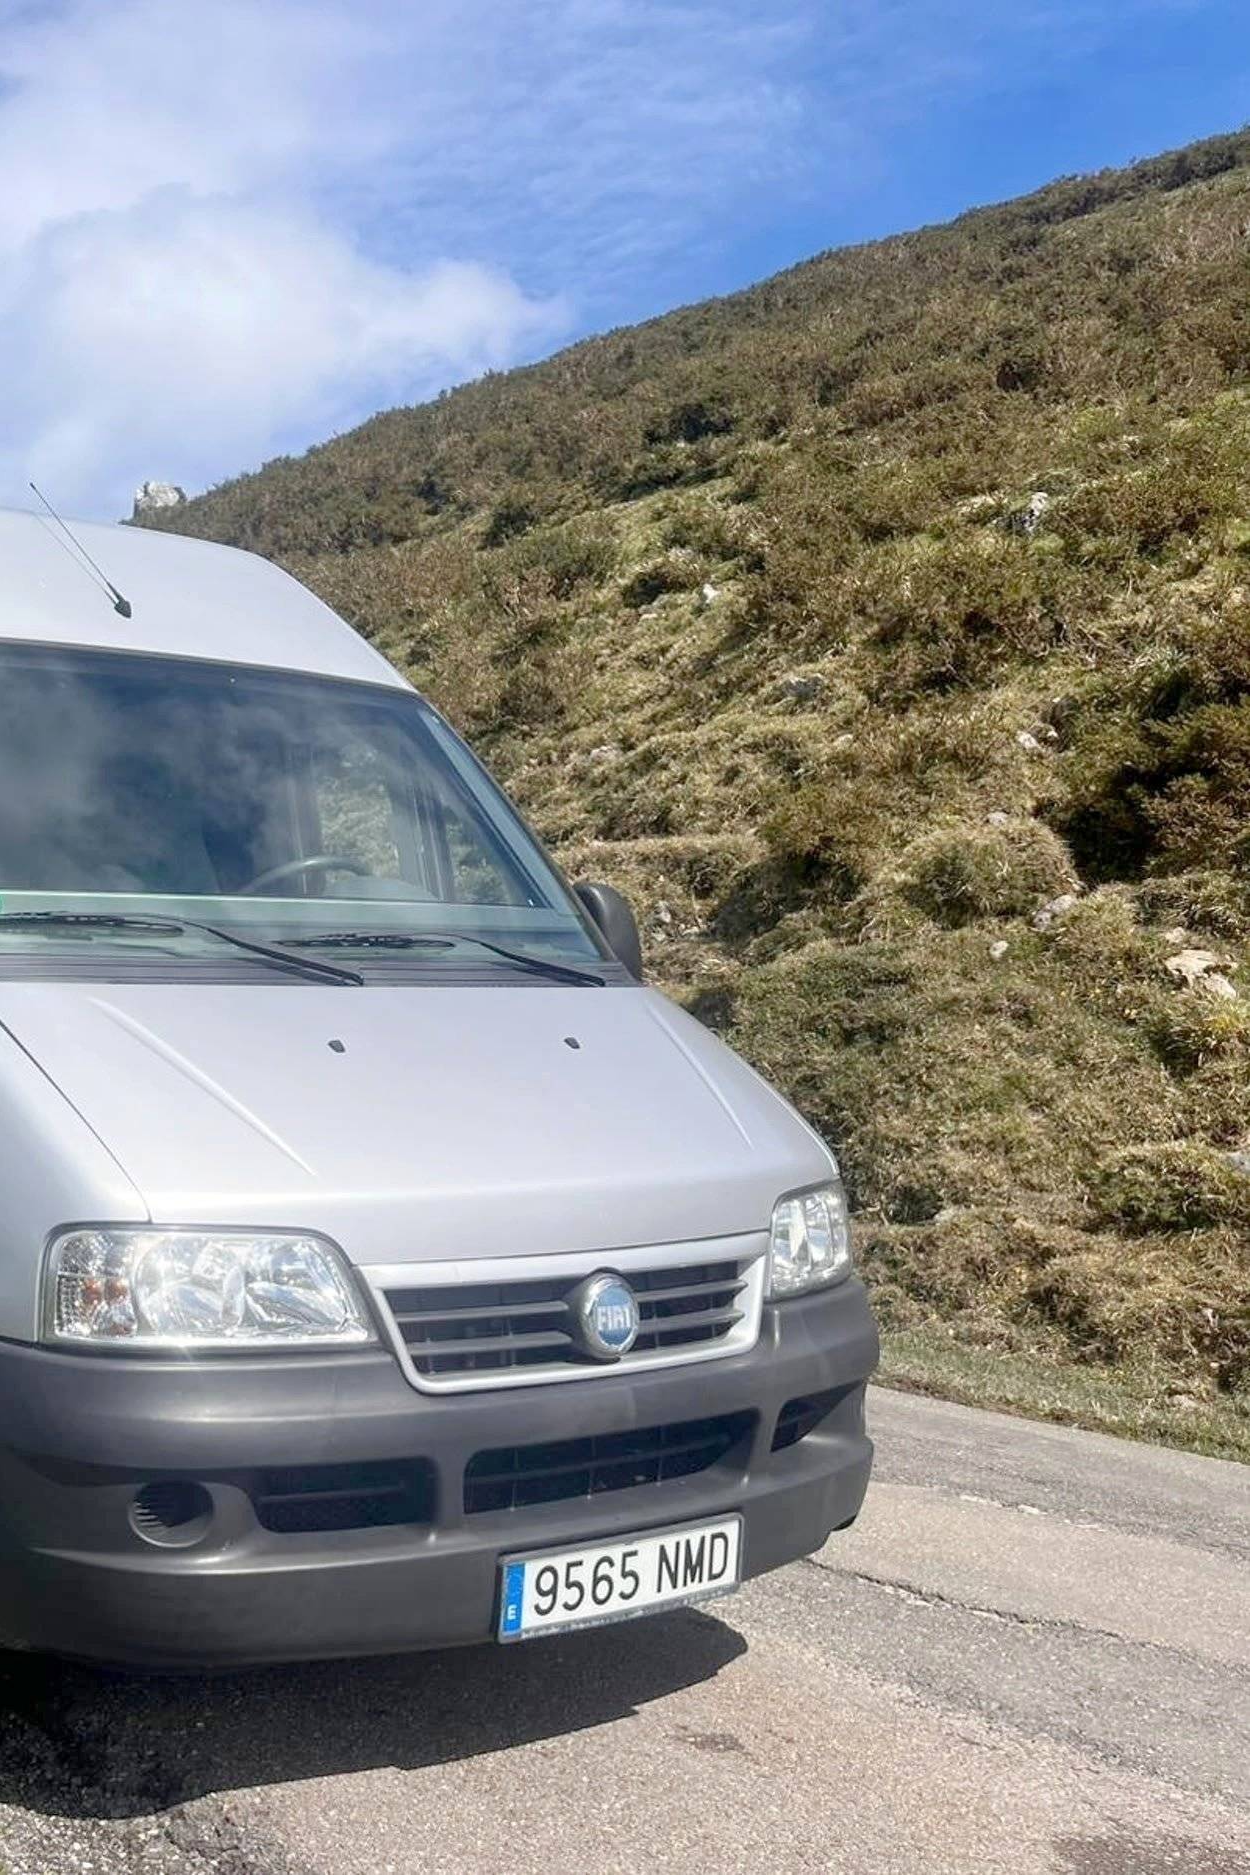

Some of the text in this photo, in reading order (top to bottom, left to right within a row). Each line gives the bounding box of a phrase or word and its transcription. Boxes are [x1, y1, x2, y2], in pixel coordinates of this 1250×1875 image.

[534, 1531, 729, 1616] 9565 NMD
[507, 1603, 517, 1620] E
